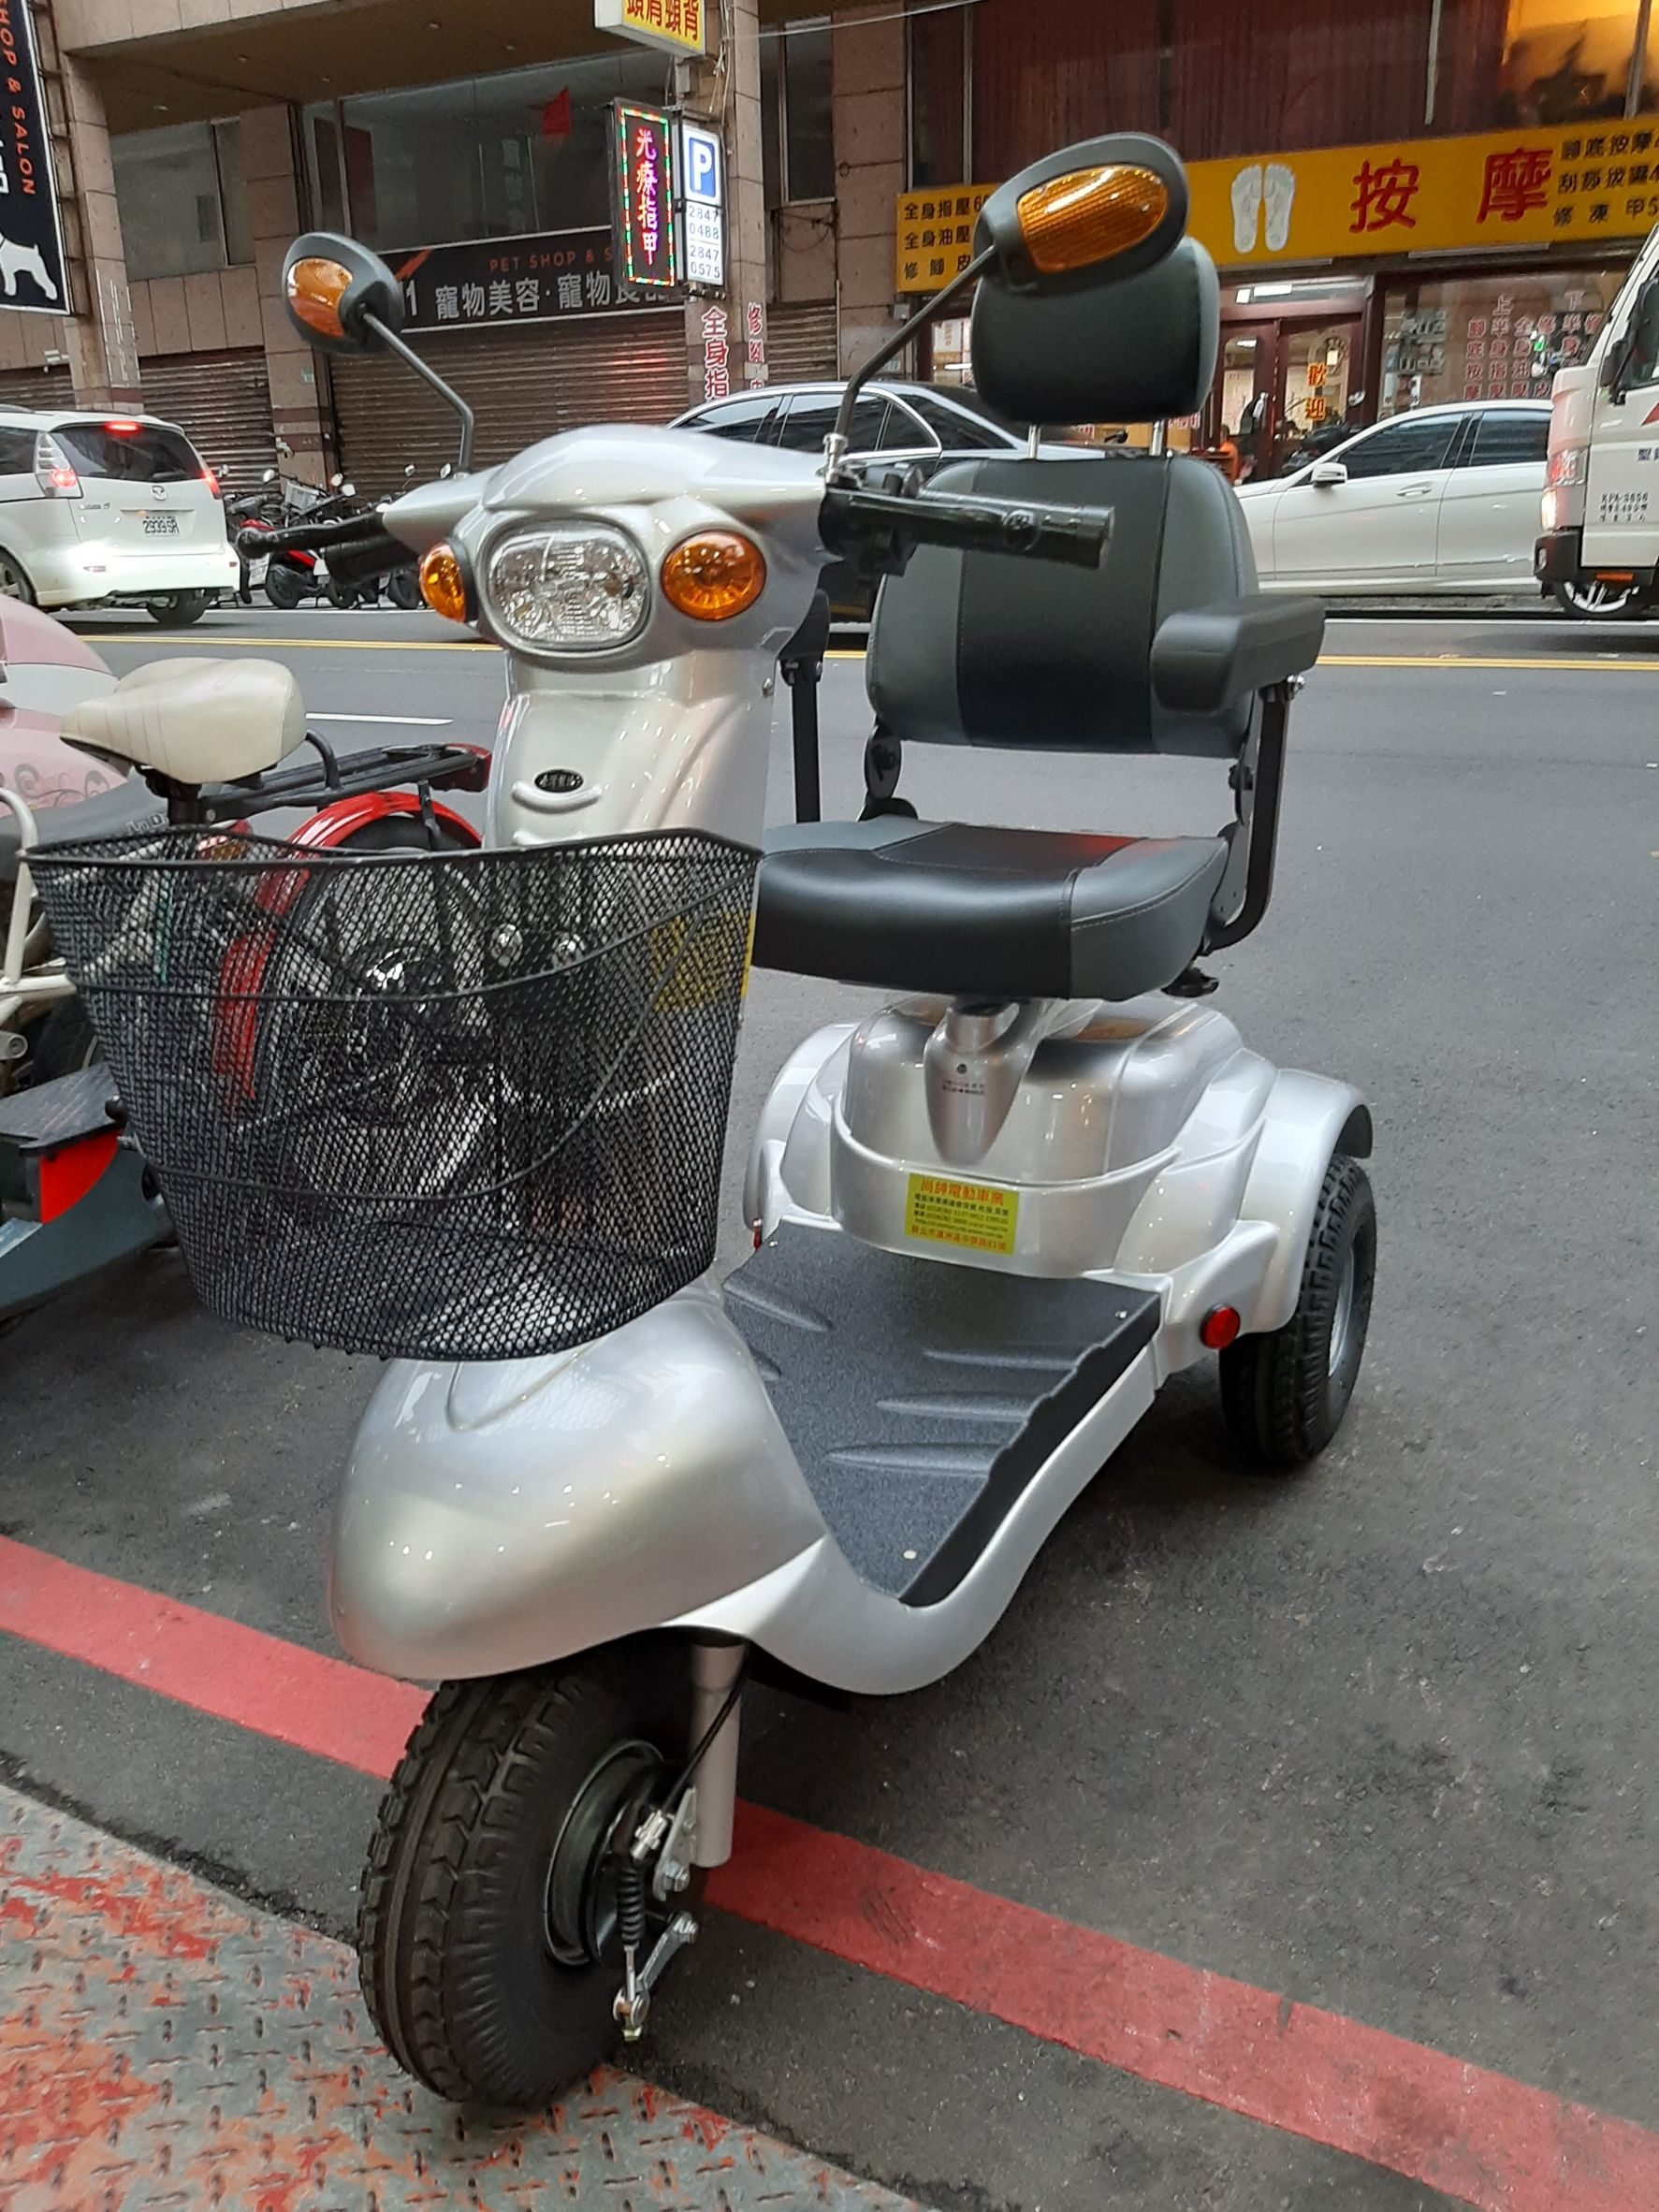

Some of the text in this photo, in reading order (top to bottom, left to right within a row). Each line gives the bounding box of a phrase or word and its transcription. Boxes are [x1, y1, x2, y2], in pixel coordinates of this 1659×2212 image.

[0, 0, 17, 65] HOP
[12, 106, 36, 195] SALON
[693, 144, 712, 191] P
[636, 127, 658, 266] 光療指甲
[1348, 147, 1554, 234] 按摩
[689, 205, 719, 223] 2847
[489, 256, 519, 272] PET
[528, 252, 576, 270] SHOP
[690, 244, 720, 262] 2847
[691, 261, 720, 279] 0575
